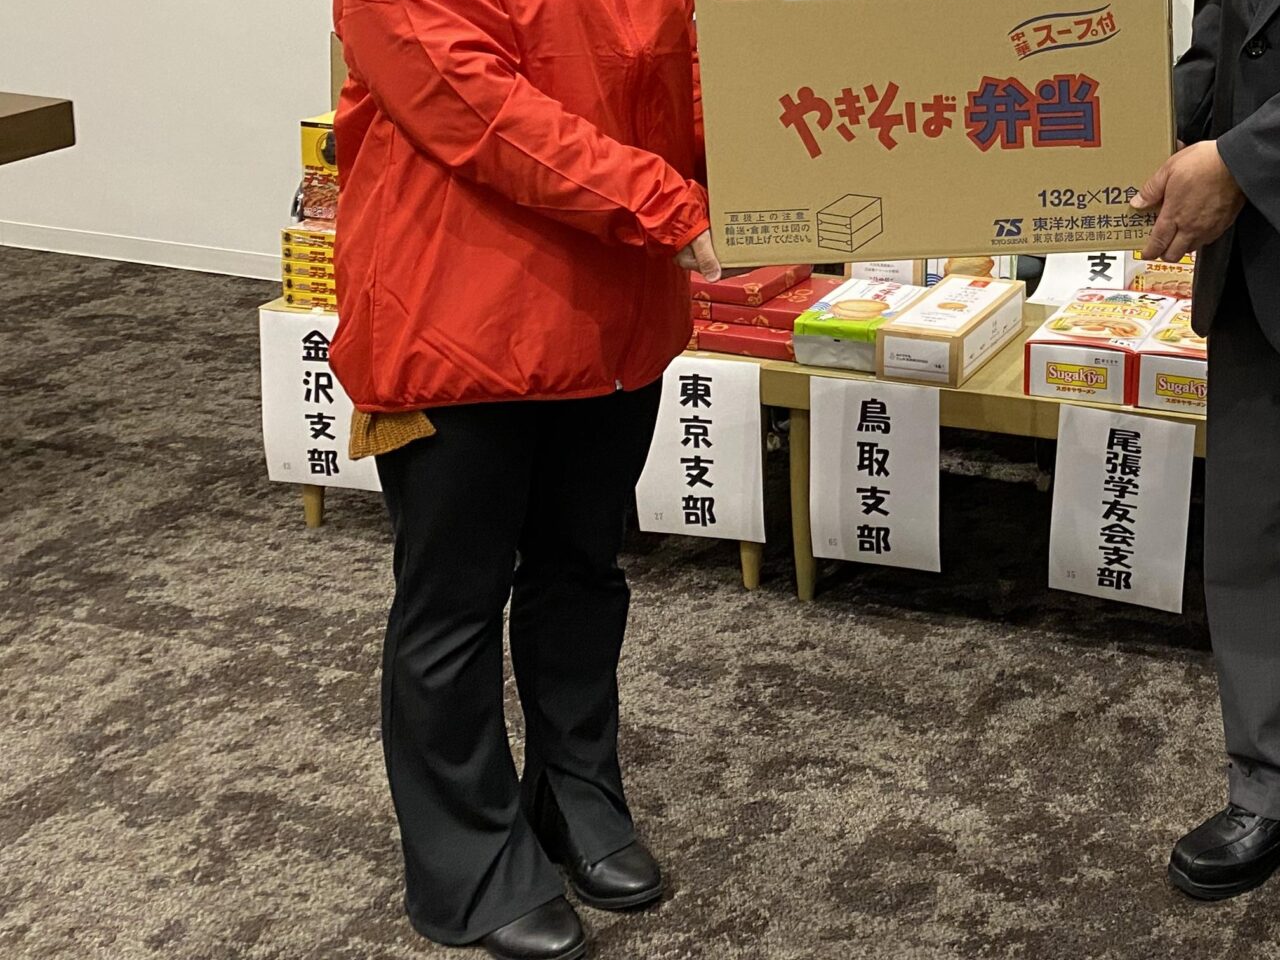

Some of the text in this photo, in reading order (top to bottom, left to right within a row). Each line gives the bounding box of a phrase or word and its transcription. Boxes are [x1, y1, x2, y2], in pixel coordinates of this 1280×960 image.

[778, 73, 1102, 160] やきそば弁当
[729, 212, 806, 222] 取扱上の注意
[1032, 213, 1158, 232] 東洋水産株式会社
[301, 329, 340, 477] 金沢支部
[1048, 365, 1105, 385] Sugakiya
[679, 373, 718, 527] 東京支部
[856, 398, 892, 556] 鳥取支部
[1096, 427, 1142, 592] 尾張学友会支部
